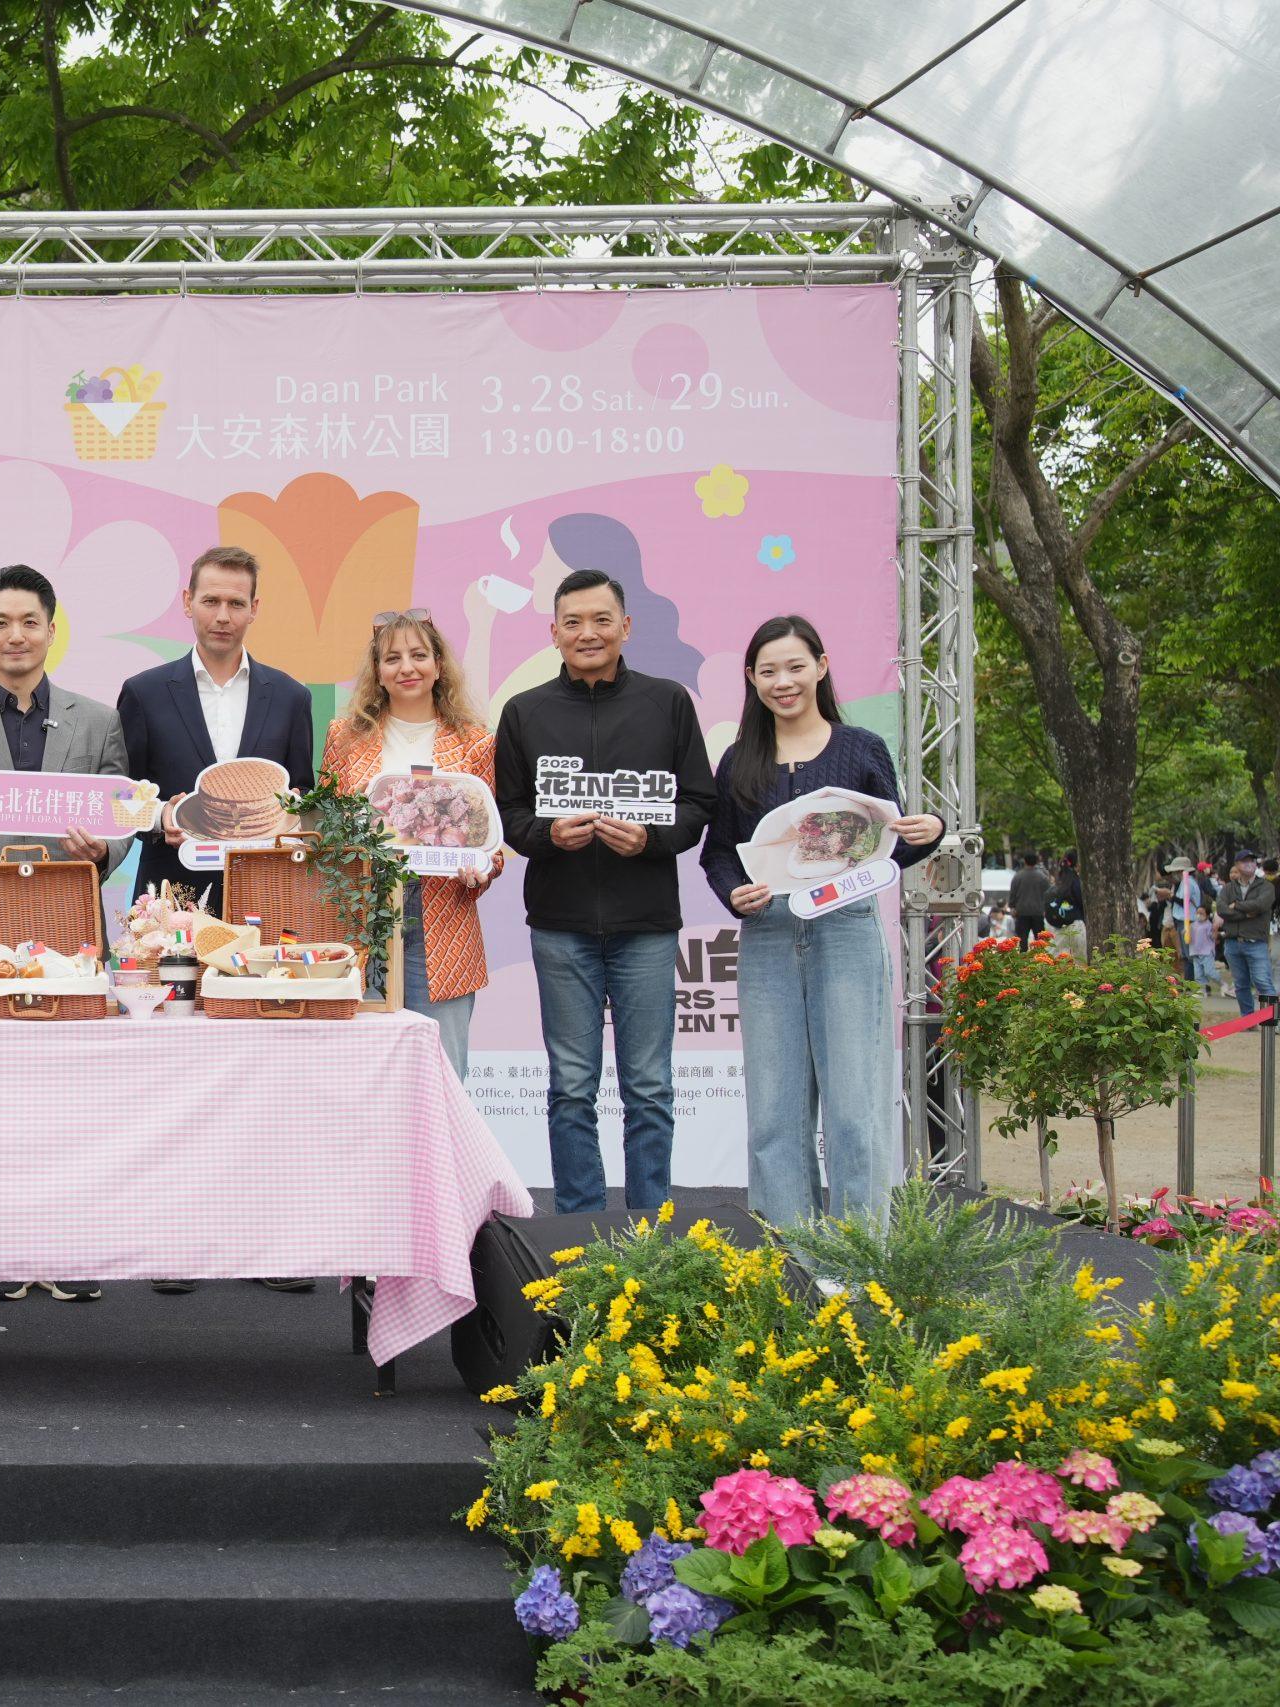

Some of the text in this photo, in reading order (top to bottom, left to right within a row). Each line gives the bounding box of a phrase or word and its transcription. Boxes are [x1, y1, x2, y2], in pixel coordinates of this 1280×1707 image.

[275, 373, 450, 404] Daan Park
[480, 374, 584, 414] 3.28
[591, 390, 644, 412] Sat.
[729, 387, 790, 409] Sun.
[175, 412, 450, 460] 大安森林公園
[480, 427, 686, 455] 13:00-18:00
[540, 759, 580, 769] 2026
[539, 799, 615, 810] FLOWERS
[25, 814, 64, 825] FLORAL
[68, 815, 104, 826] PICNIC
[616, 812, 672, 823] TAIPEI
[838, 872, 875, 895] 刈包
[679, 1014, 715, 1033] IN
[475, 1088, 515, 1099] Office,
[705, 1088, 745, 1099] Office,
[484, 1105, 529, 1117] District,
